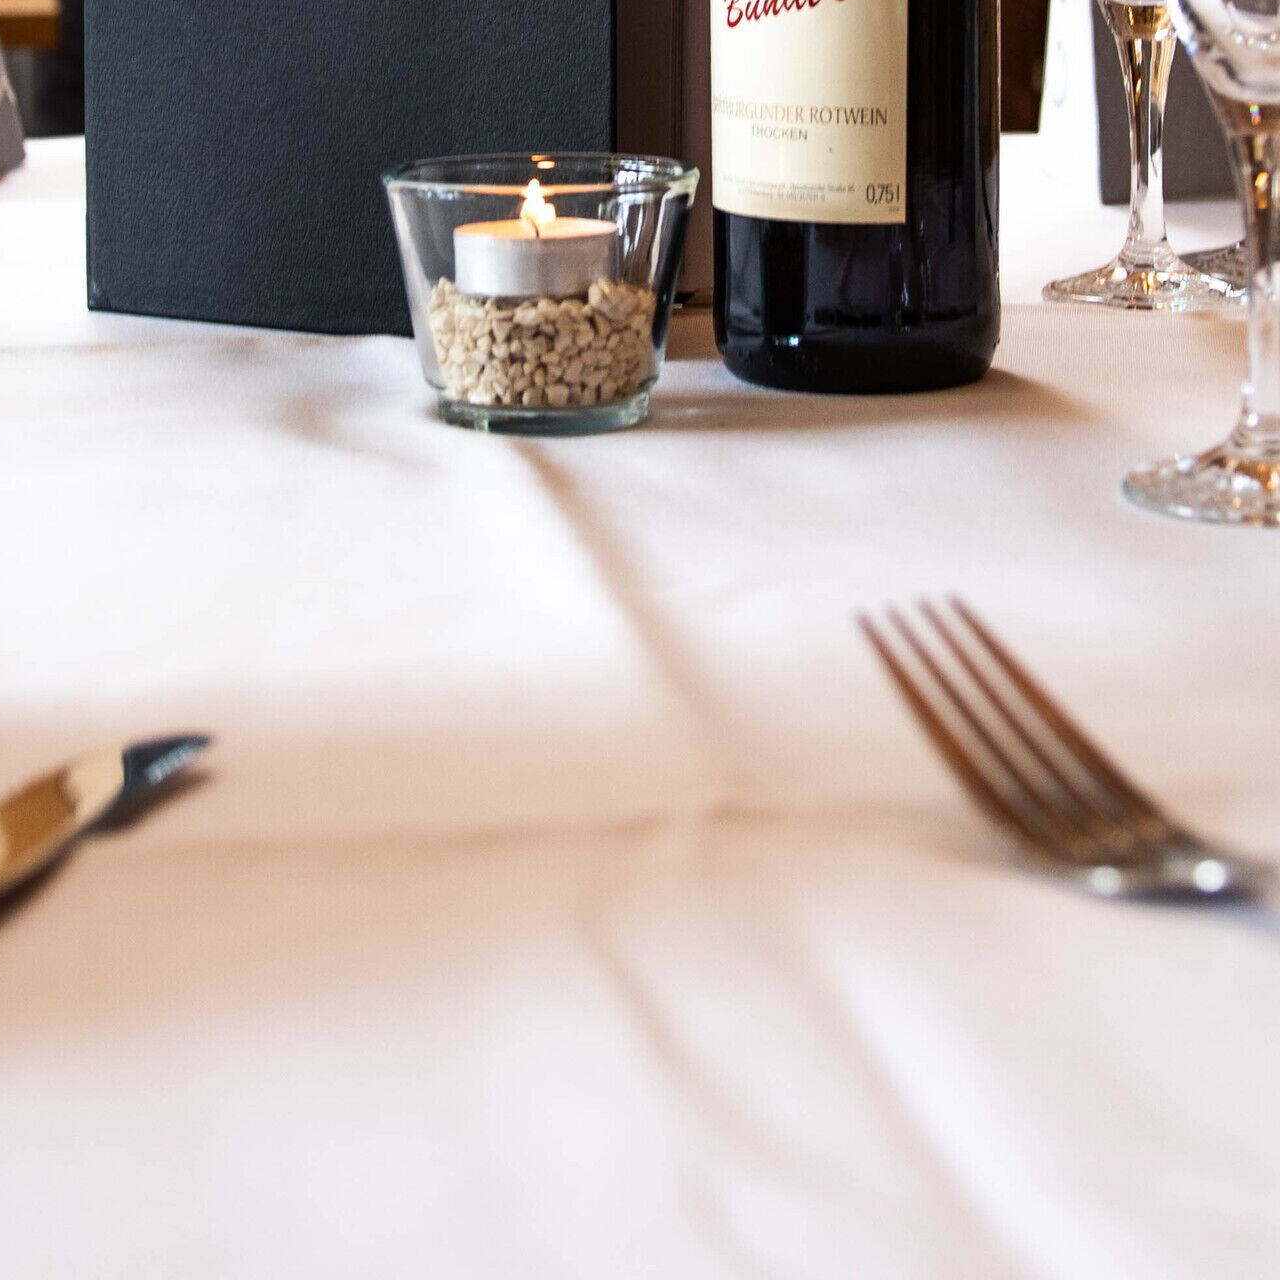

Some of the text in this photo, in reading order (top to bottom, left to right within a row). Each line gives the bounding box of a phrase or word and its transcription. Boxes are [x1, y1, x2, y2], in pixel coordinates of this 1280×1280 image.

[712, 97, 888, 126] TBURGUNDER ROTWEIN
[751, 124, 808, 140] TROCKEN
